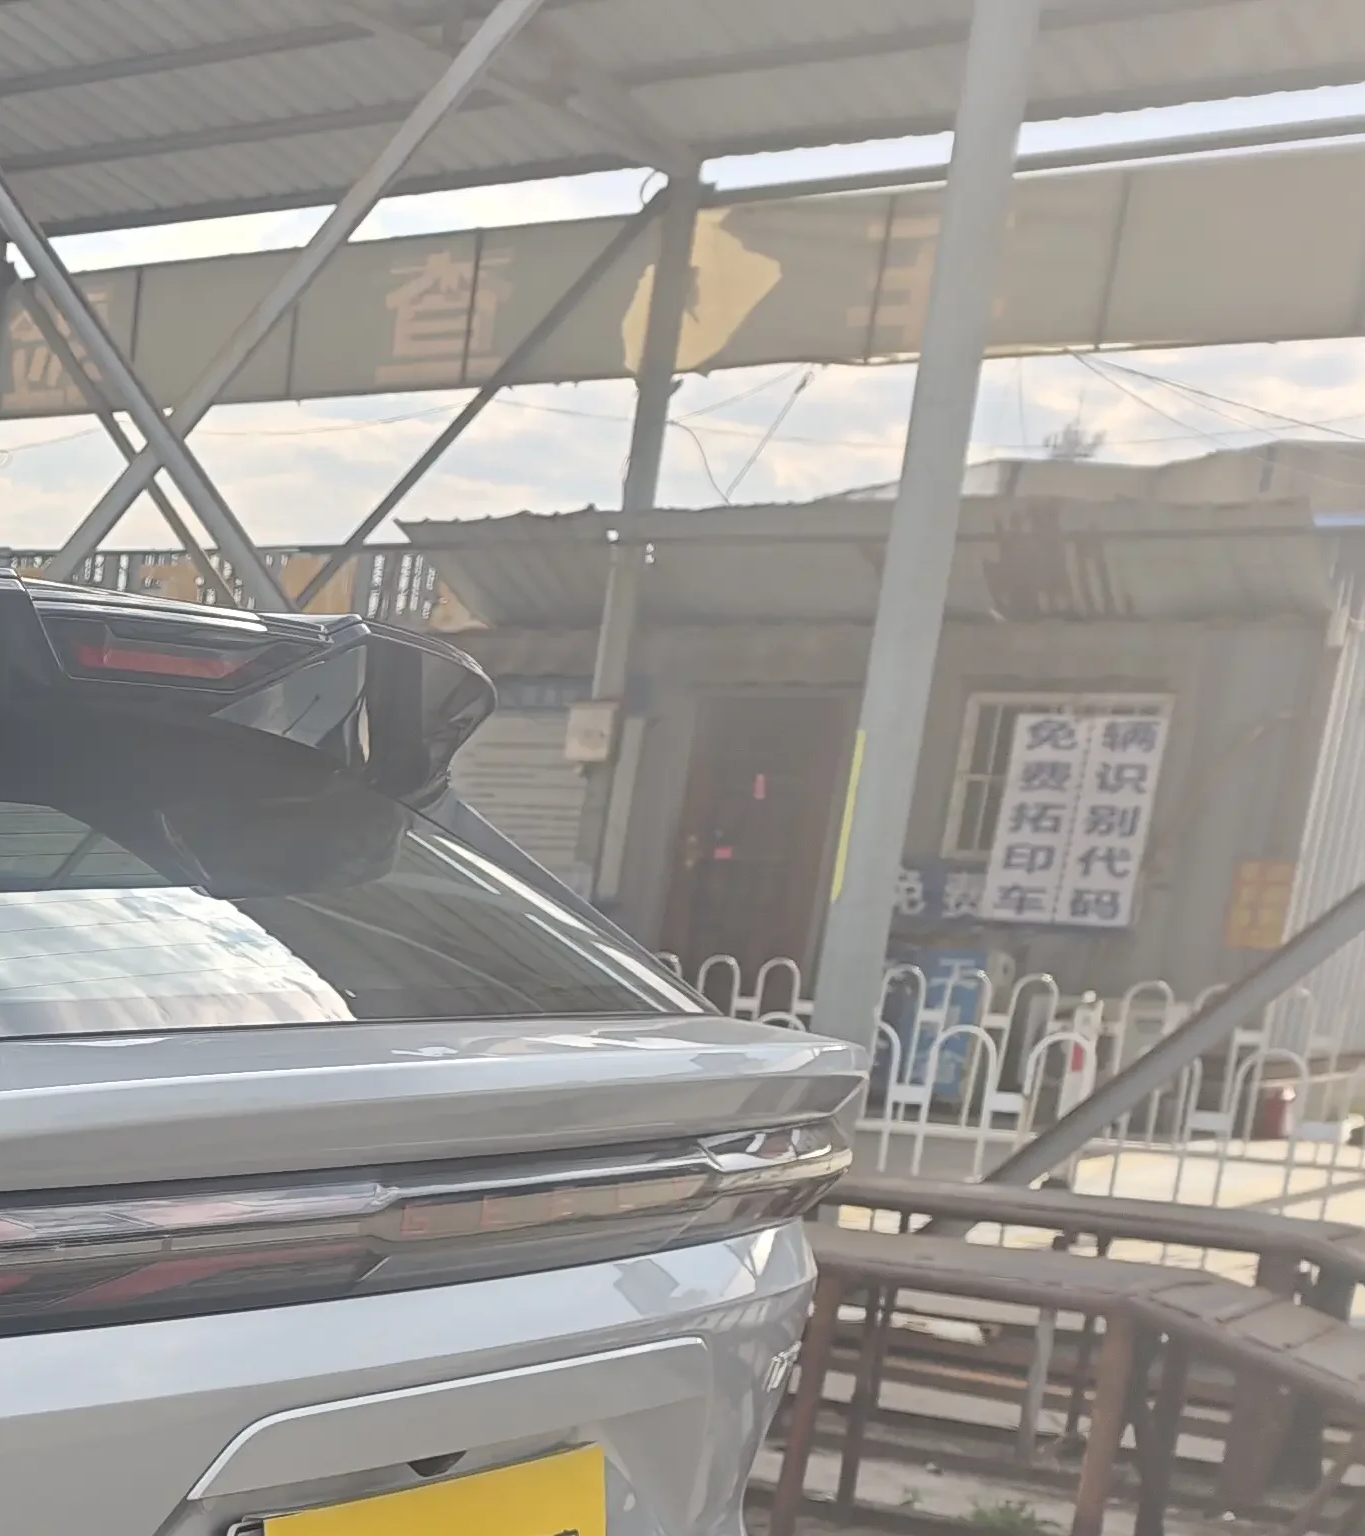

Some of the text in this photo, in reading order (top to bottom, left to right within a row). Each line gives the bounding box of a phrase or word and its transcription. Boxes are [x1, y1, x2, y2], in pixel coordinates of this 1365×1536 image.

[992, 717, 1078, 916] 免费拓印车
[1069, 719, 1162, 921] 辆识别代码
